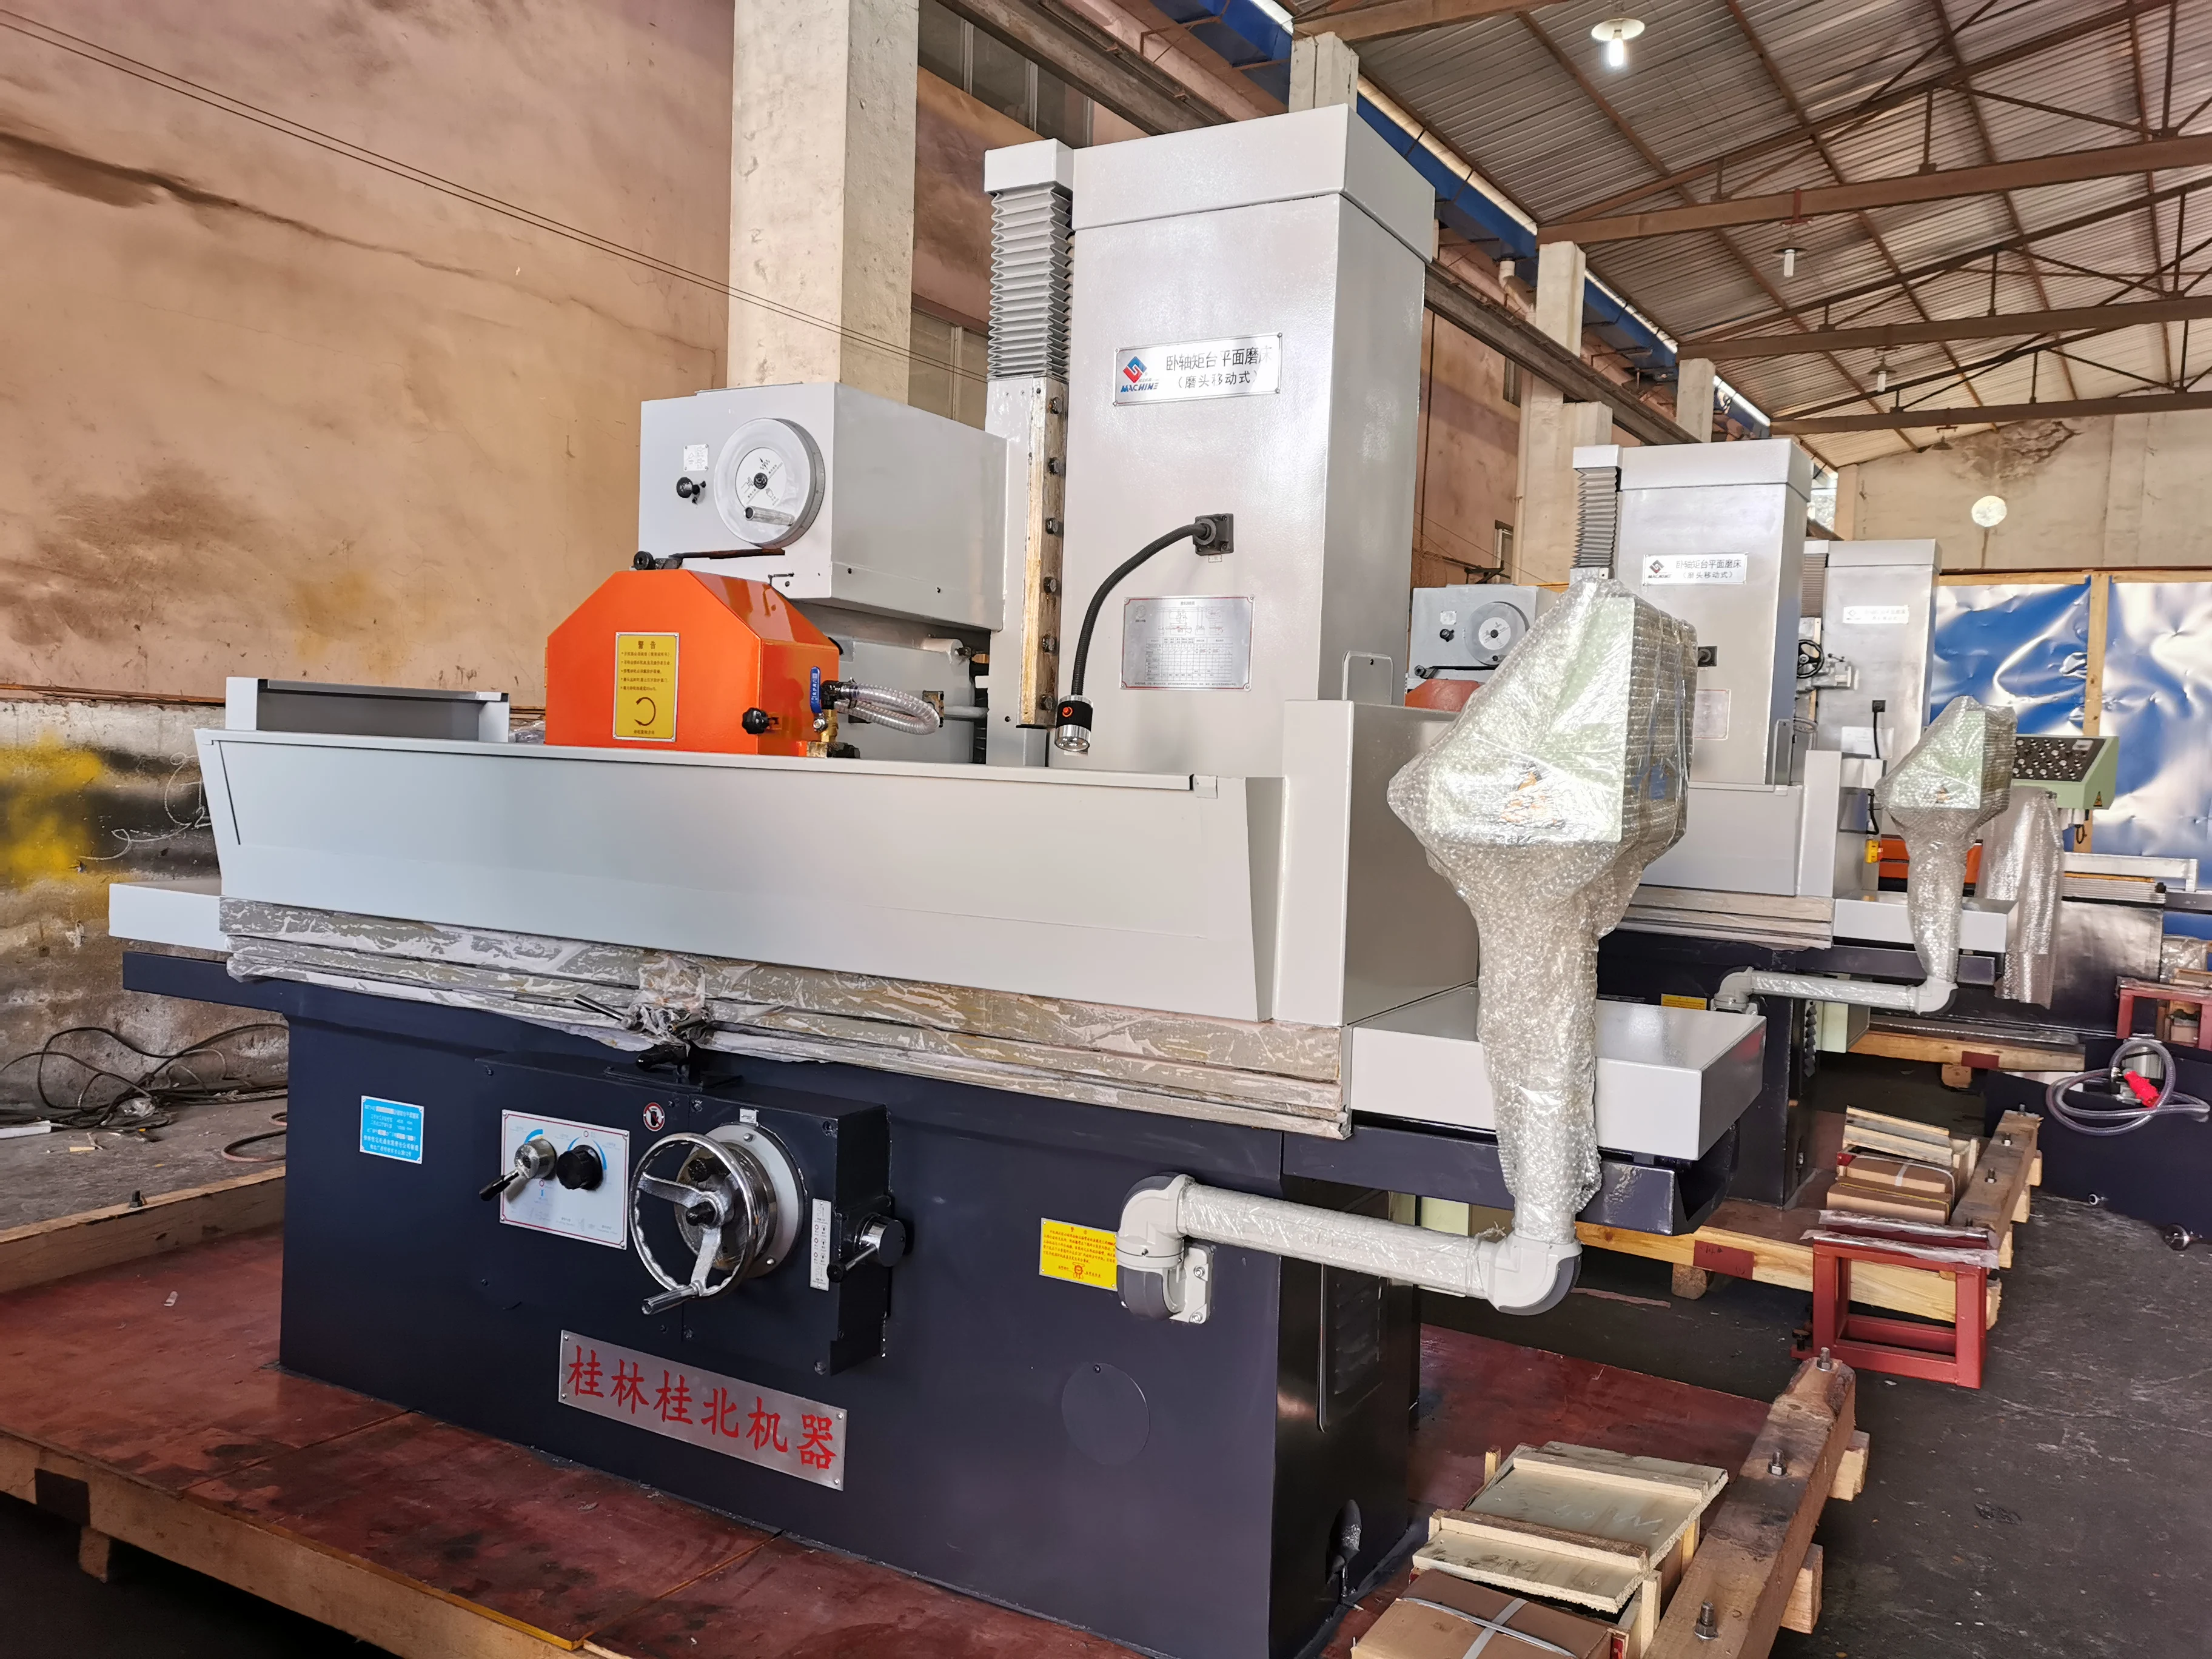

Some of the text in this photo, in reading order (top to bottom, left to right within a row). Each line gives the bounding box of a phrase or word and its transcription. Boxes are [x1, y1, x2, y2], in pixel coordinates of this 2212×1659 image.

[1121, 383, 1159, 392] MACHINE
[567, 1345, 837, 1470] 桂林桂北机器
